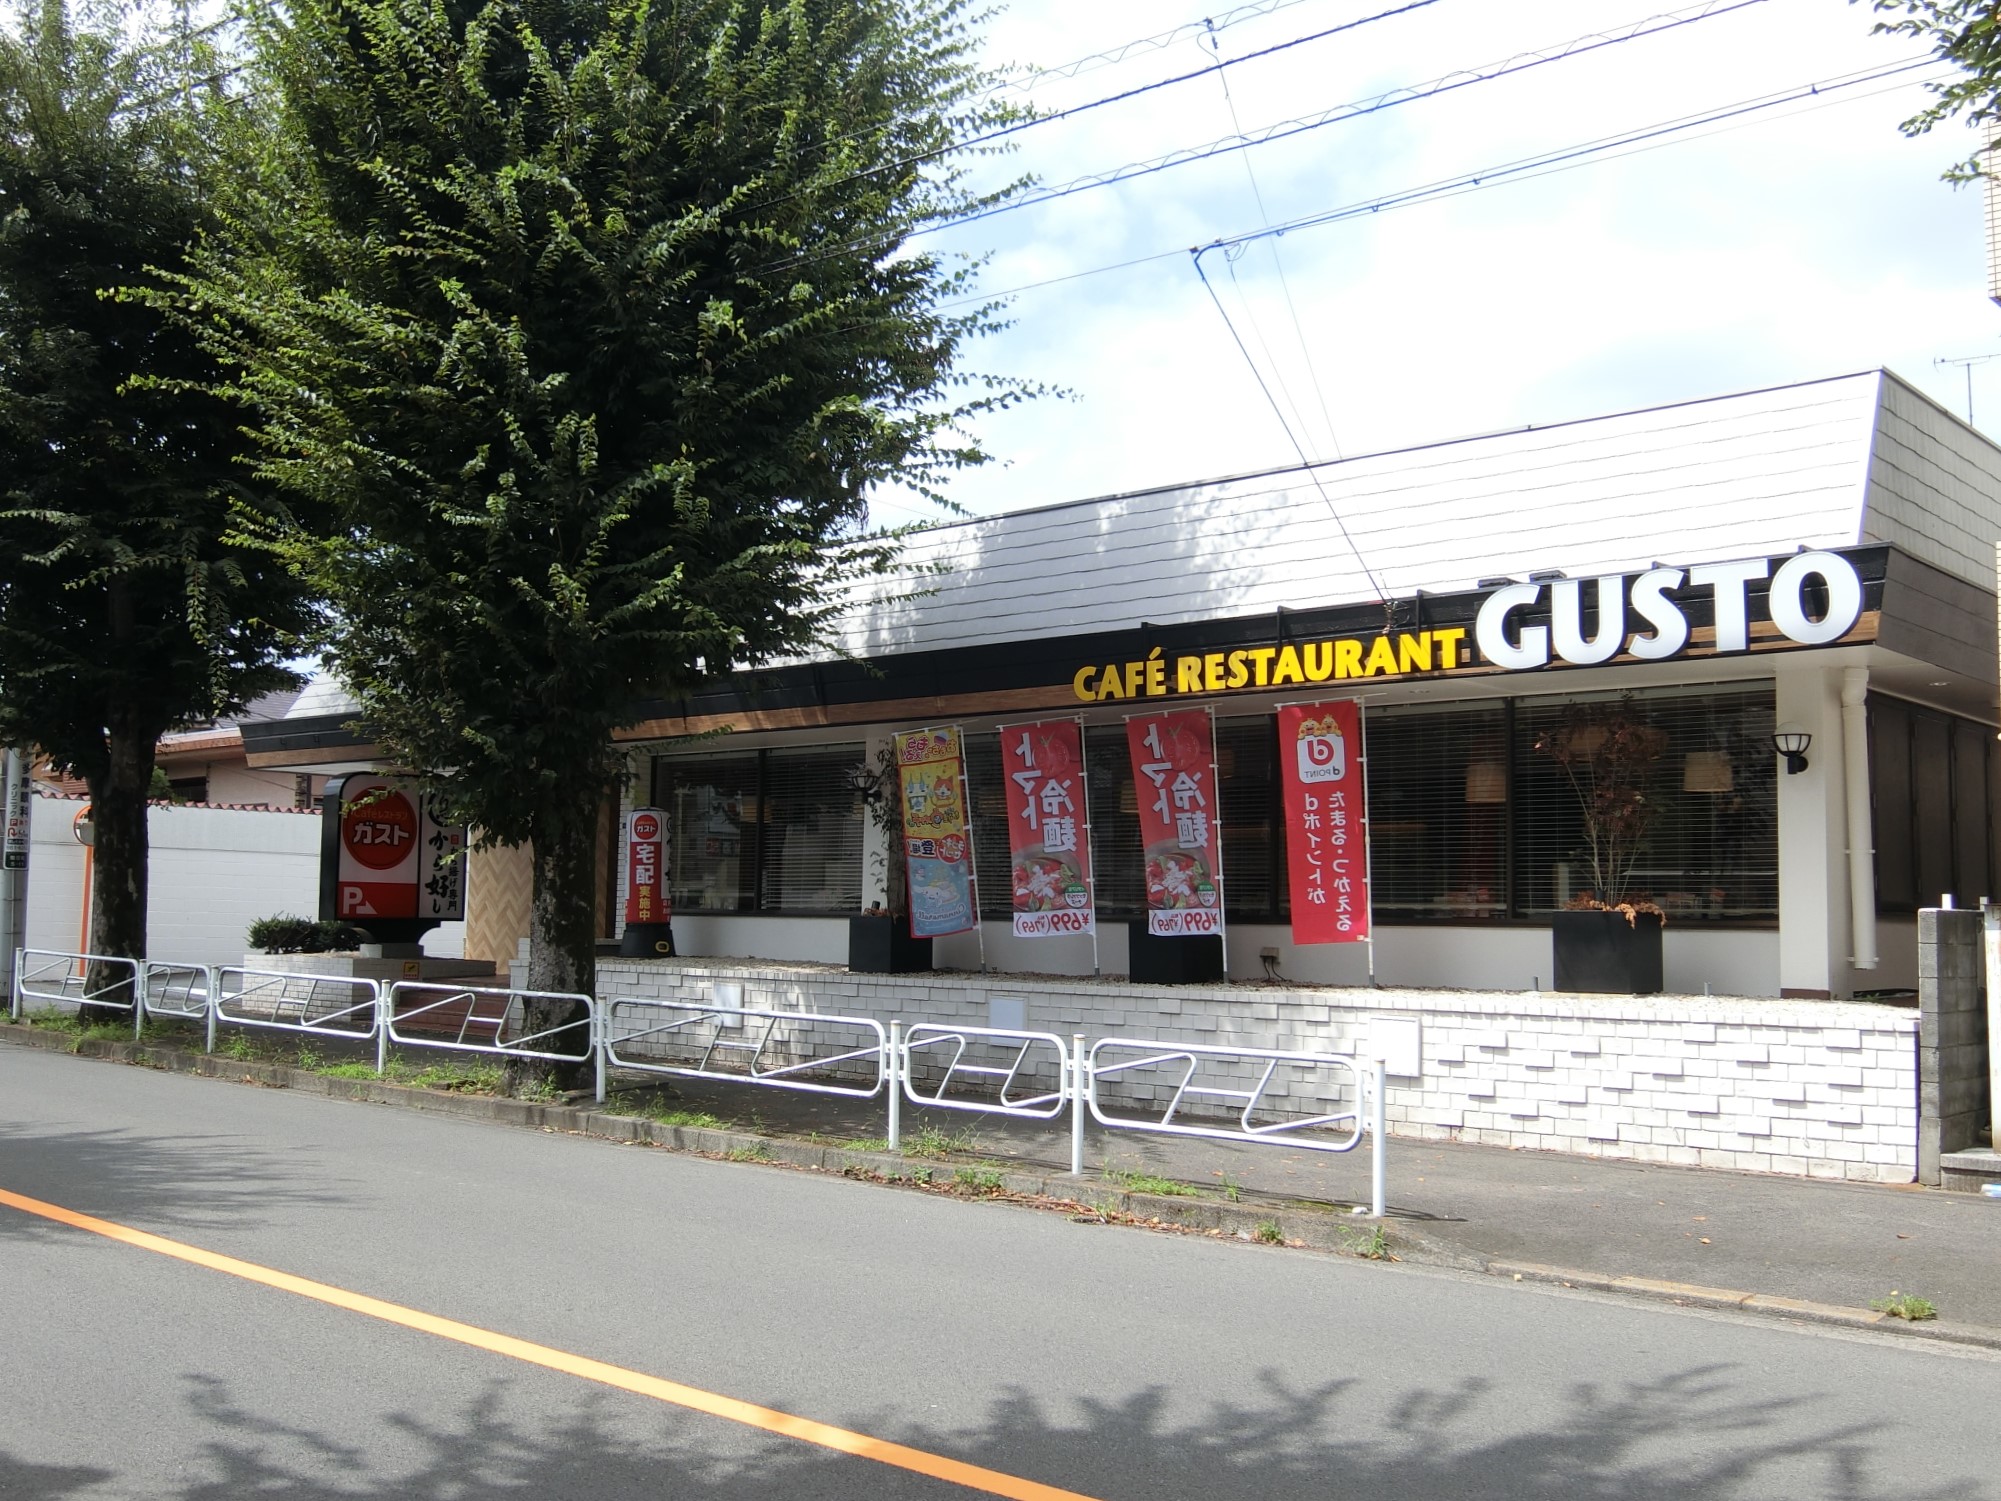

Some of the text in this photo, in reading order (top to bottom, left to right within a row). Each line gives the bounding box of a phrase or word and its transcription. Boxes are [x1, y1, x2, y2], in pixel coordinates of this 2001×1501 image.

[1073, 551, 1862, 701] CAFÉ RESTAURANT GUSTO
[9, 783, 18, 818] クリニック
[353, 821, 410, 846] ガスト
[636, 825, 656, 833] ガスト
[425, 830, 449, 914] から好し
[636, 844, 655, 885] 宅配
[343, 886, 363, 914] P
[639, 885, 651, 921] 実施中
